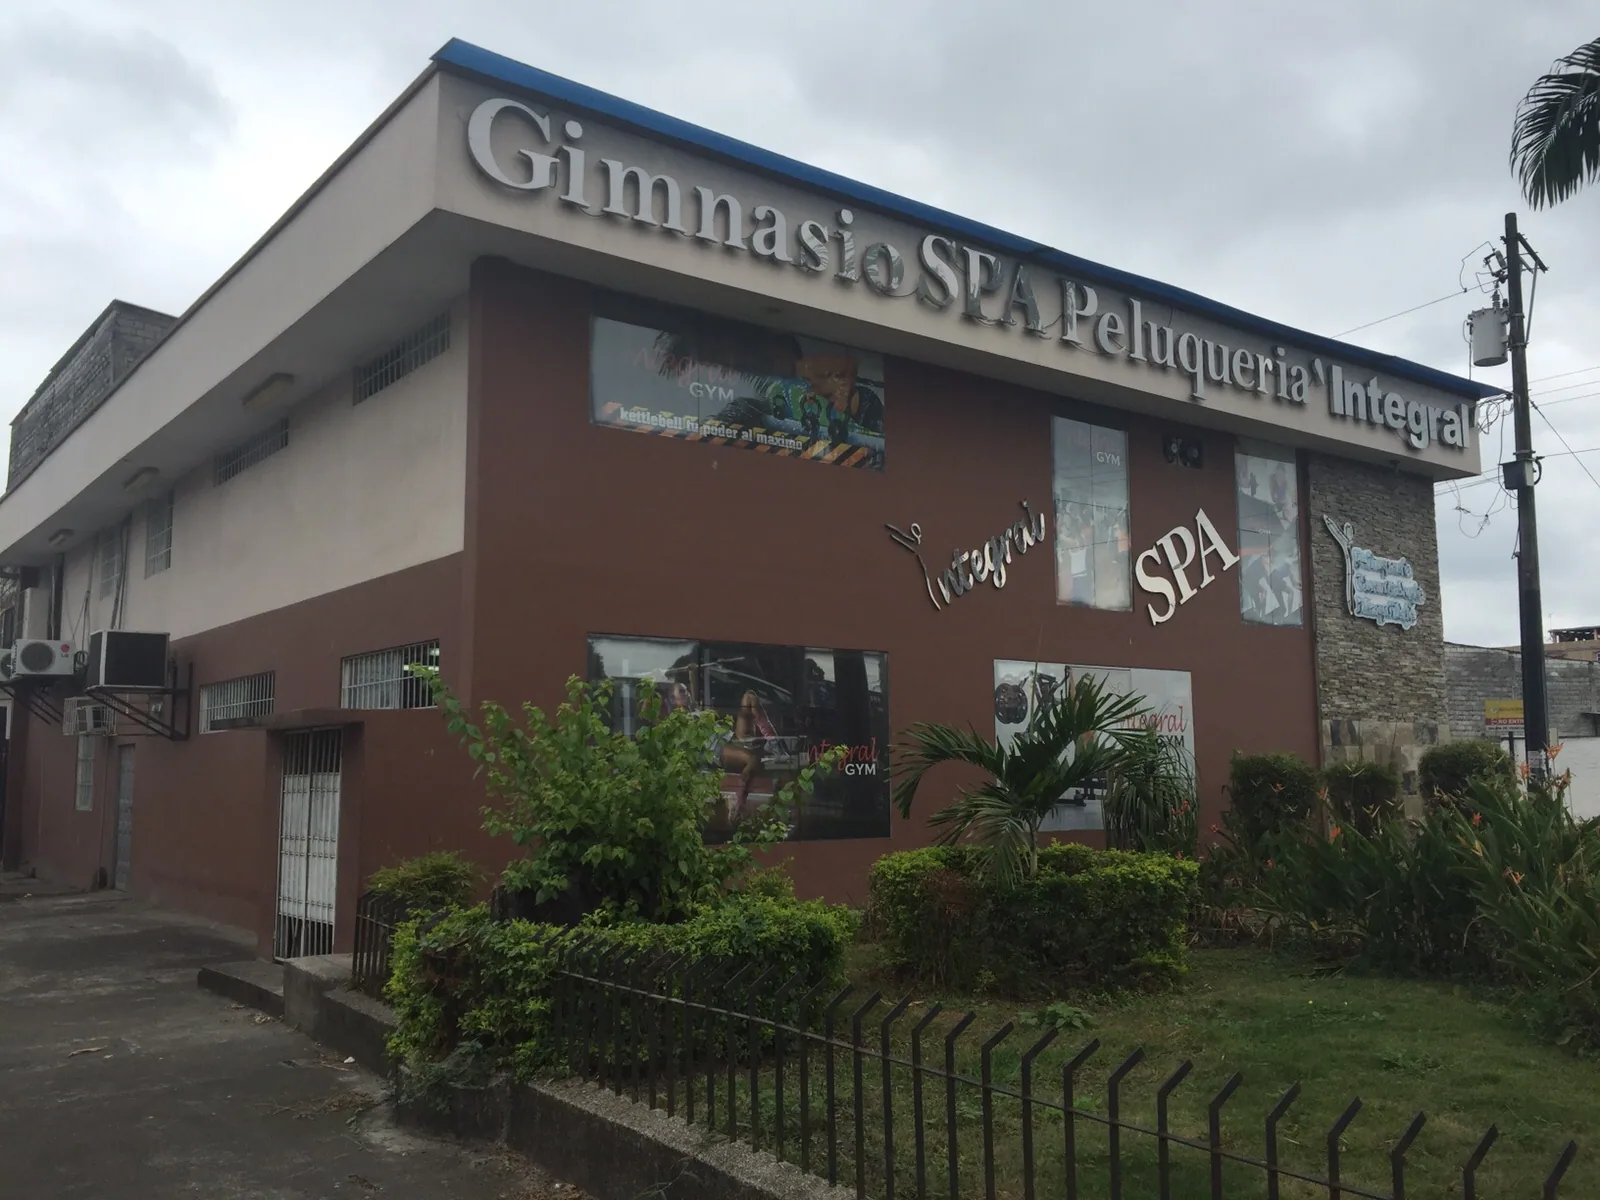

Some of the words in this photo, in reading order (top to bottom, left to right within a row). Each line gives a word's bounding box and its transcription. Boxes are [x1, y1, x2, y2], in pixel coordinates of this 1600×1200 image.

[467, 97, 905, 296] Gimnasio
[916, 234, 1048, 335] SPA
[1061, 278, 1309, 405] Peluqueria
[689, 381, 735, 402] GYM
[619, 406, 684, 430] kettlebell
[700, 423, 738, 439] poder
[741, 428, 753, 441] al
[756, 432, 803, 450] maximo
[1096, 451, 1121, 467] GYM
[884, 498, 1046, 611] Integral
[1134, 507, 1240, 627] SPA
[807, 736, 880, 772] ntgral
[844, 763, 877, 776] GYM
